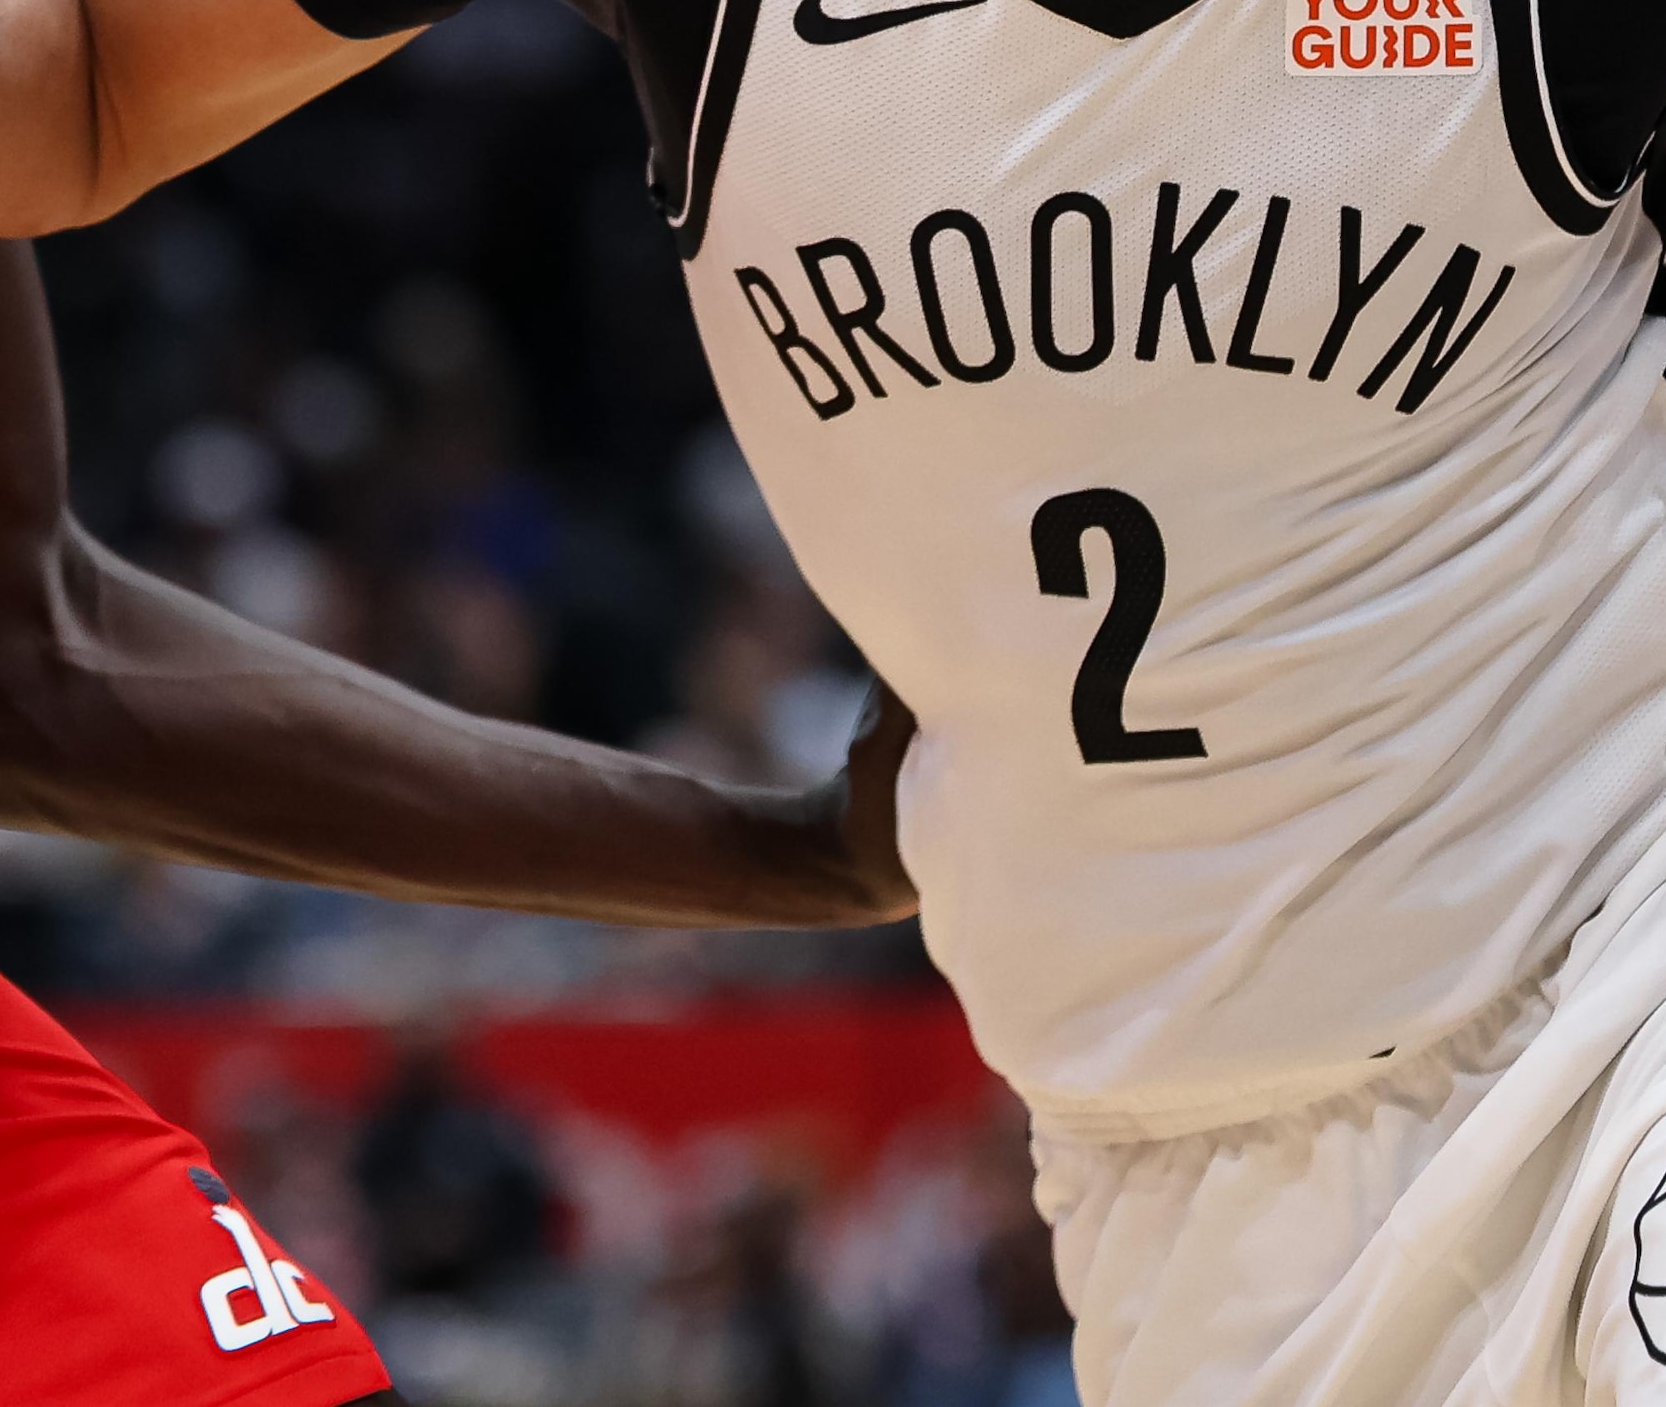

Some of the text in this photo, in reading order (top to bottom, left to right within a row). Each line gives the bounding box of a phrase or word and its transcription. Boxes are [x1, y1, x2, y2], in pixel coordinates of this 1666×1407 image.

[1291, 23, 1474, 69] GUIDE
[735, 182, 1517, 421] BROOKLYN
[1030, 488, 1209, 765] 2
